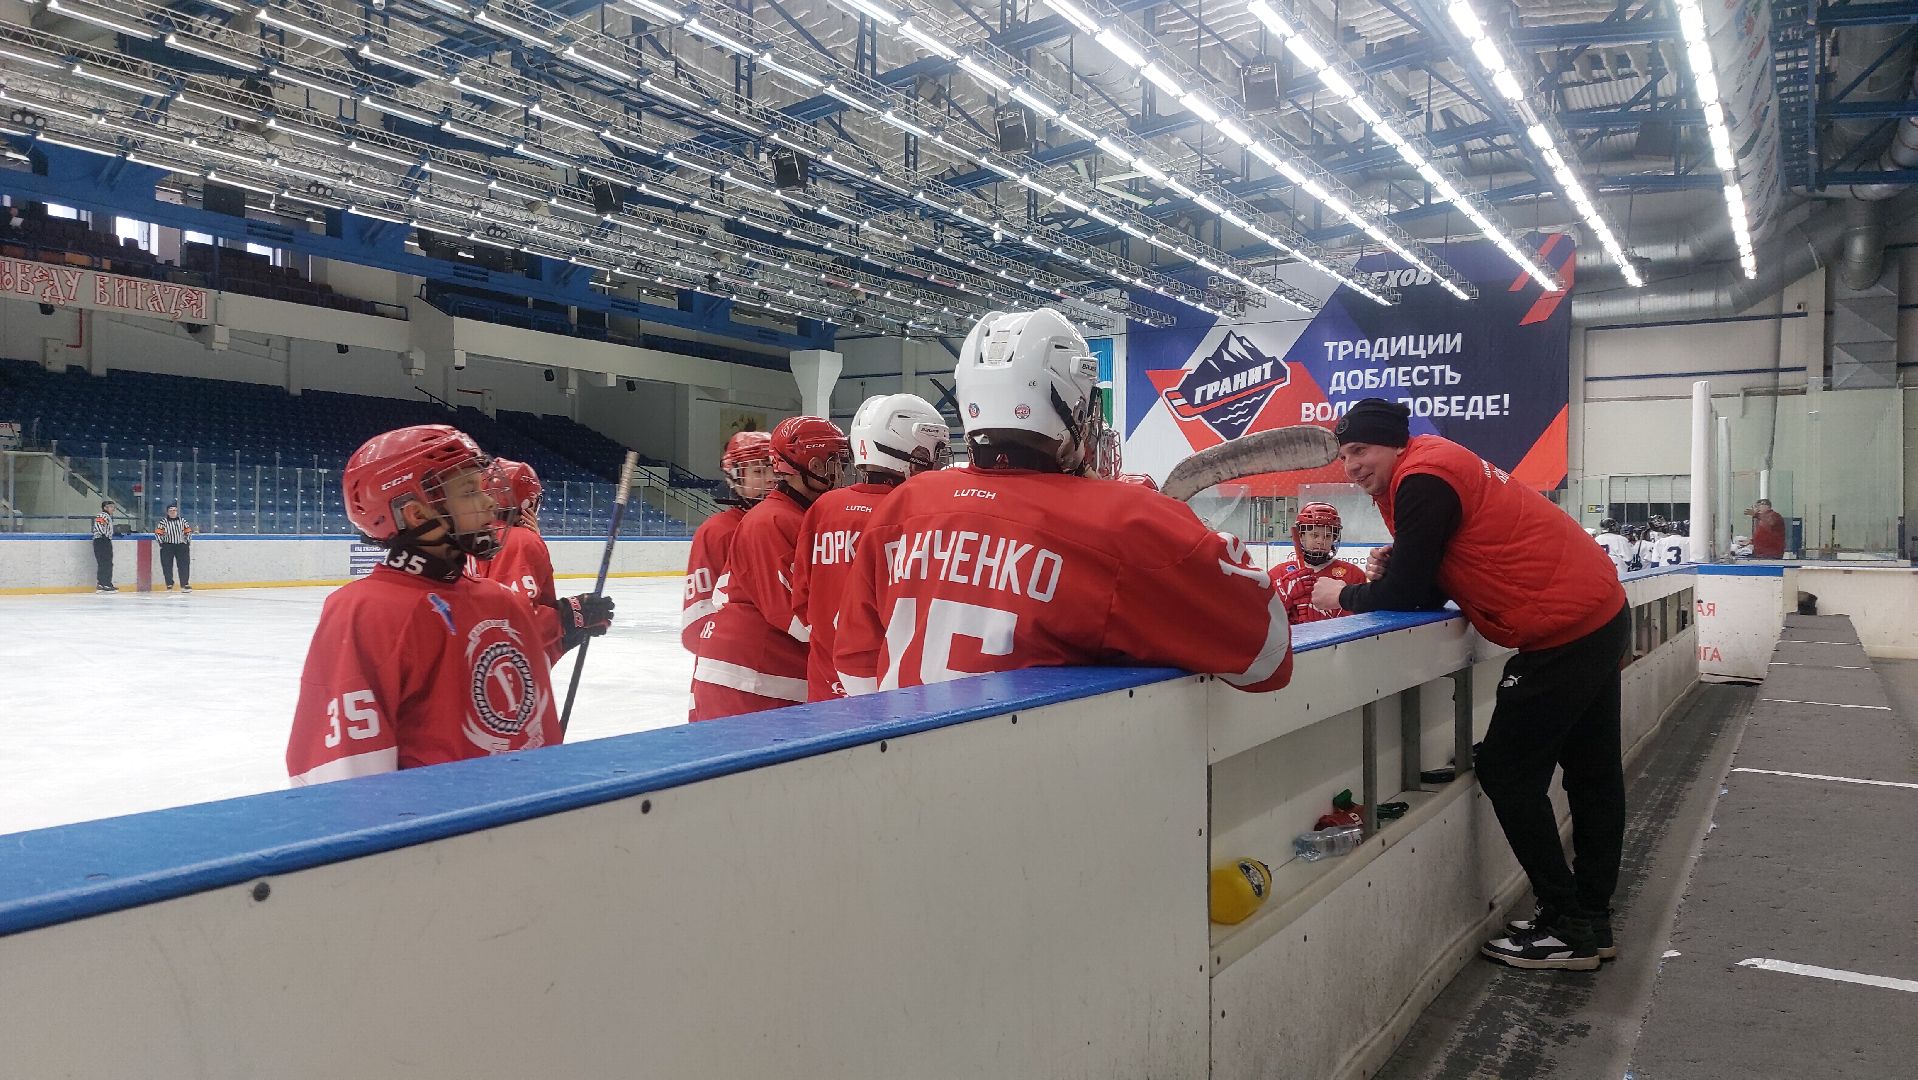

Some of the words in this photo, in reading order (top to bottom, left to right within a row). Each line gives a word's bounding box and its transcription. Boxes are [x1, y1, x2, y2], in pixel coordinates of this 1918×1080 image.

[1324, 332, 1462, 361] ТРАДИЦИИ
[1194, 360, 1274, 405] ГРАНИТ
[1329, 364, 1461, 394] ДОБЛЕСТЬ
[1301, 400, 1360, 422] ВОЛ
[859, 439, 868, 460] 4
[381, 472, 414, 490] CCM
[953, 488, 997, 500] LUTCH
[845, 505, 873, 513] LUTCH
[388, 550, 427, 575] 35
[1667, 546, 1682, 565] 3
[324, 689, 381, 749] 35
